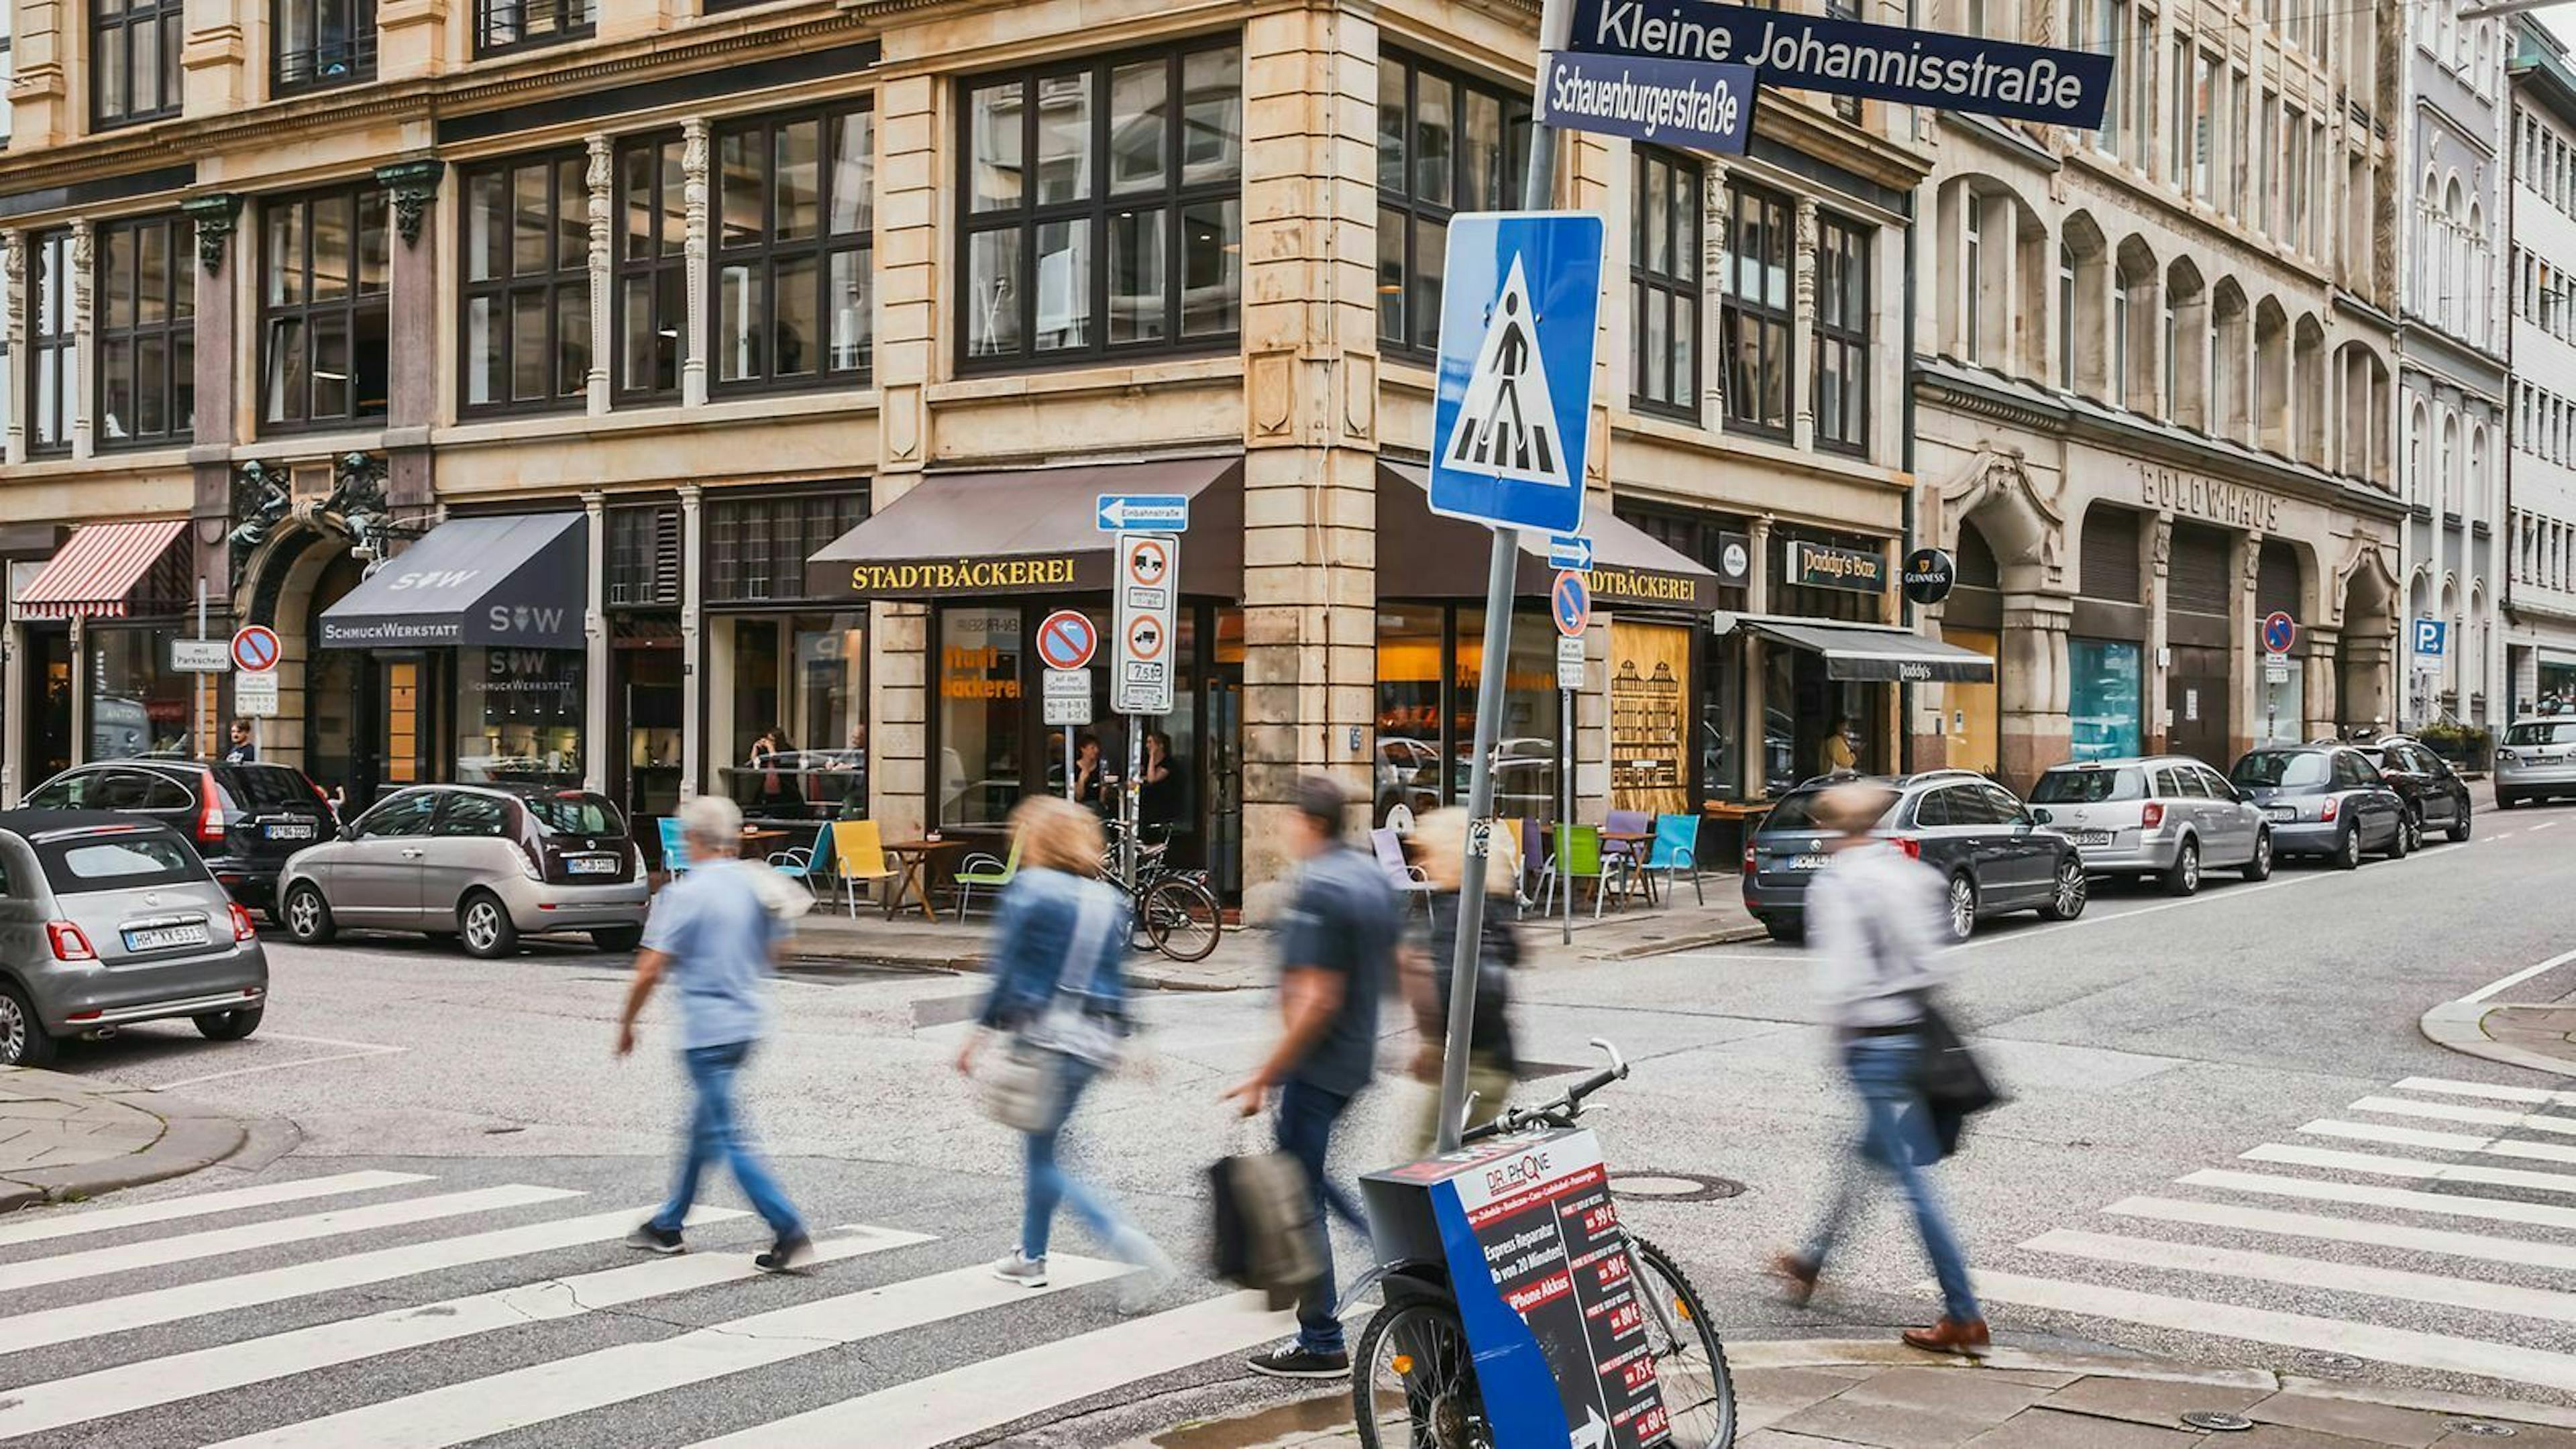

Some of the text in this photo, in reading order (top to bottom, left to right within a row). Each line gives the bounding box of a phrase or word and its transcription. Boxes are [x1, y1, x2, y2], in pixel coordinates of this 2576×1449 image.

[1597, 0, 2081, 109] Kleine Johannisstraße
[1552, 64, 1737, 137] Schauenburgerstraße
[1122, 508, 1179, 517] Einbahnstraße
[852, 559, 1075, 590] STADTBÄCKEREI
[1803, 548, 1852, 581] Paddy's
[1905, 572, 1945, 584] GUINNESS
[2418, 624, 2437, 651] P
[177, 656, 225, 664] Parkschein
[1486, 1170, 1507, 1189] DR.
[1595, 1207, 1608, 1227] 99
[1607, 1203, 1615, 1222] €
[1483, 1223, 1555, 1262] Express Reparatur
[1515, 1256, 1529, 1275] 20
[1607, 1258, 1621, 1278] 90
[1619, 1254, 1627, 1273] €
[1509, 1276, 1570, 1310] iPhone Akkus
[1631, 1302, 1640, 1320] €
[1633, 1360, 1647, 1381] 75
[1645, 1356, 1654, 1375] €
[1647, 1411, 1660, 1432] 60
[1658, 1407, 1667, 1425] €
